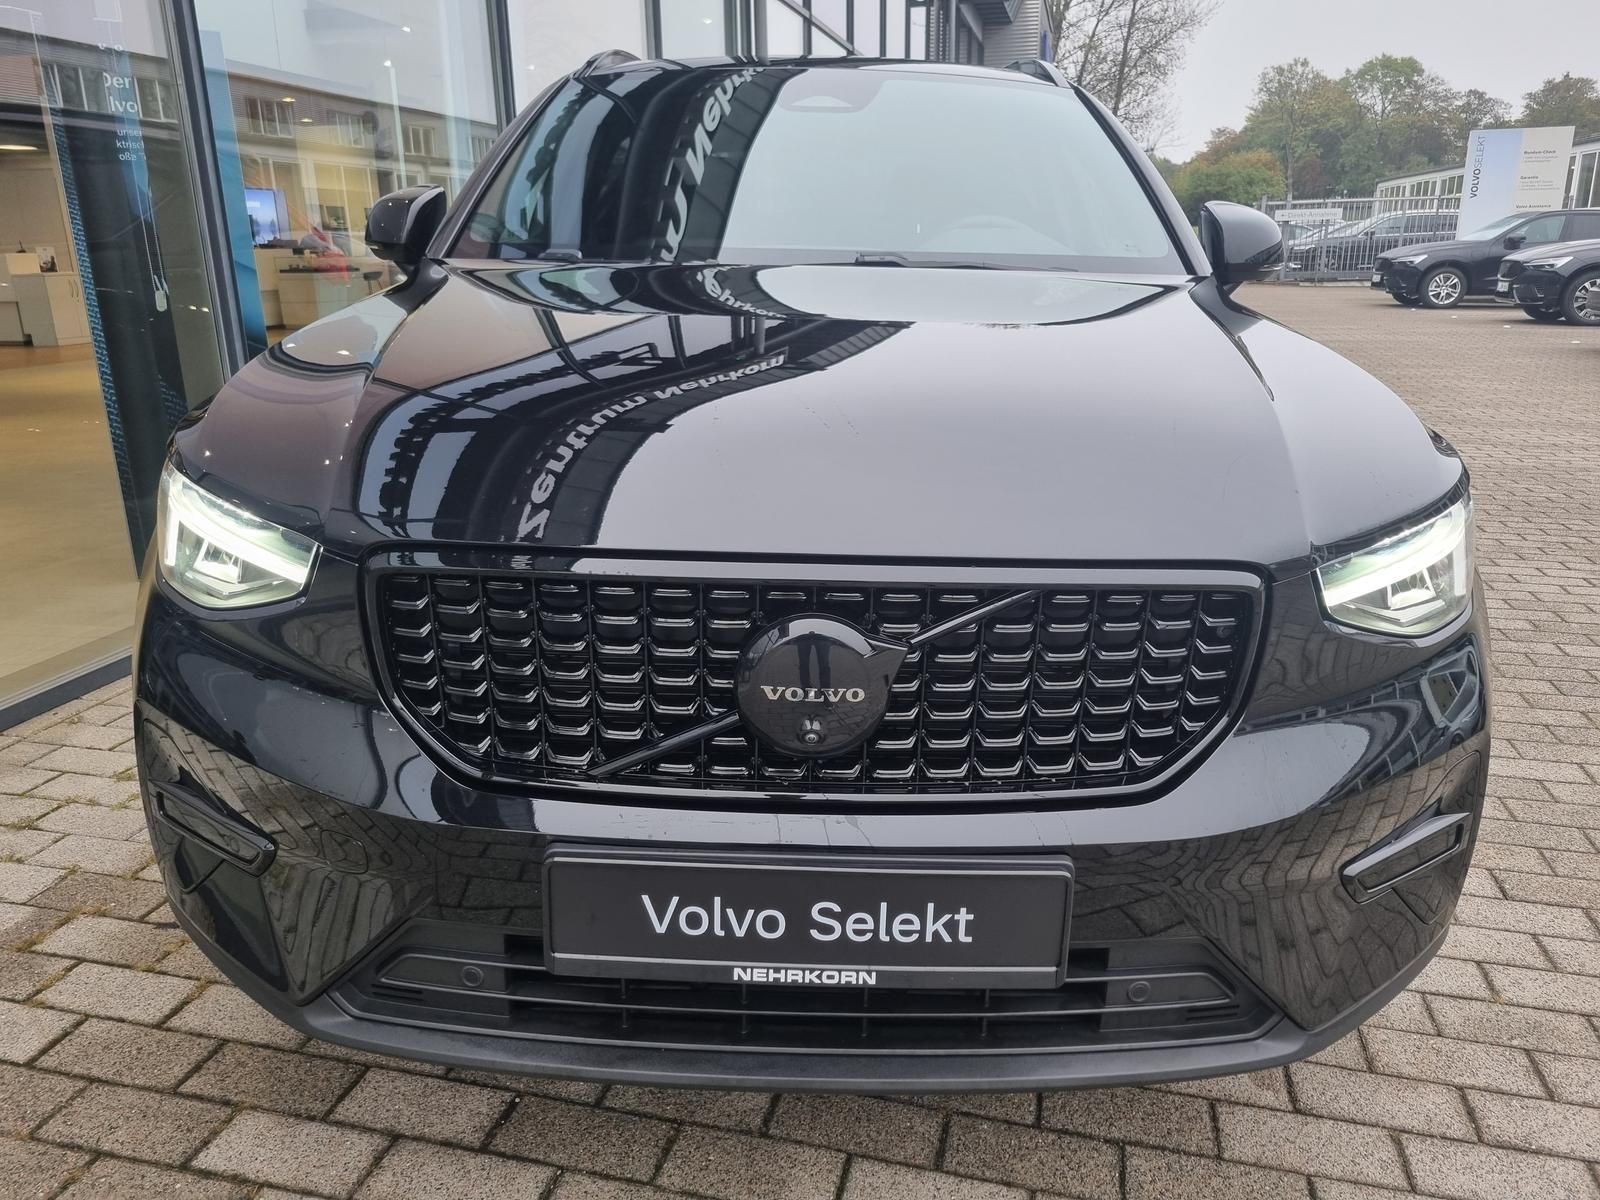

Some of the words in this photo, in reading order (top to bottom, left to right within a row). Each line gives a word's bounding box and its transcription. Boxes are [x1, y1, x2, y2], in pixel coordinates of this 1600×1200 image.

[109, 95, 138, 113] lvo
[760, 685, 865, 703] VOLVO
[641, 894, 786, 940] Volvo
[809, 901, 975, 943] Selekt
[733, 967, 877, 985] NEHRKORN
